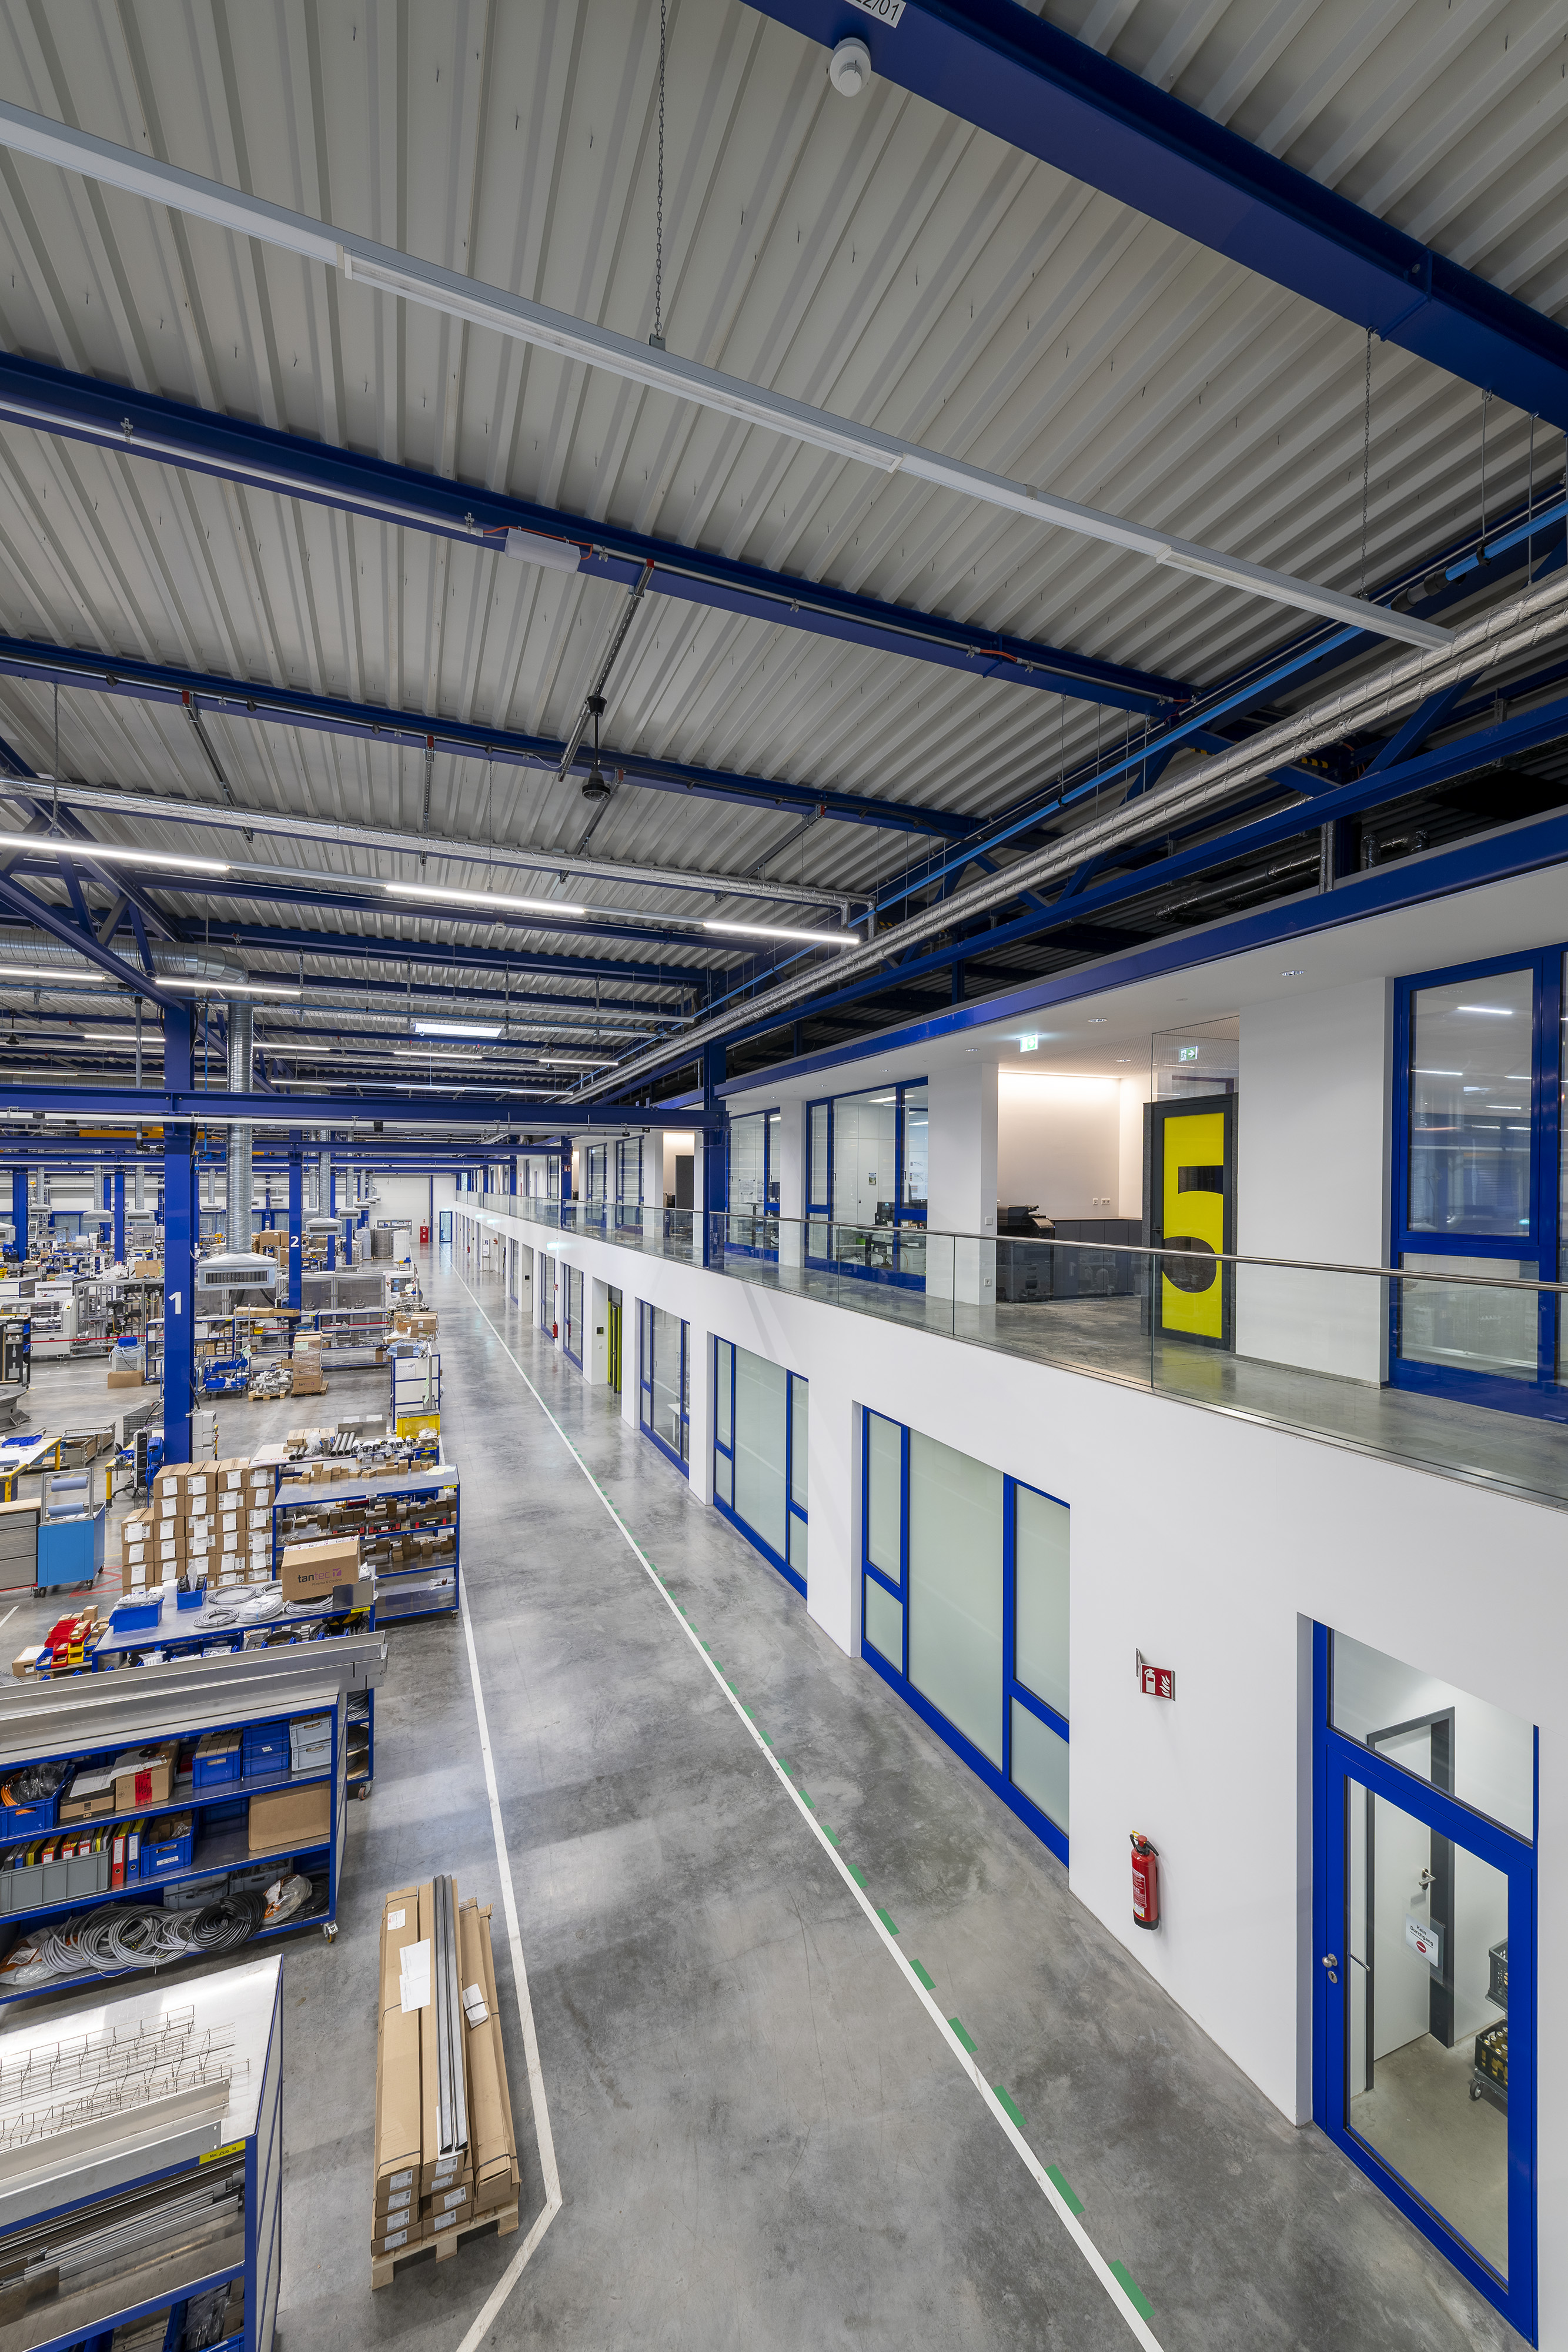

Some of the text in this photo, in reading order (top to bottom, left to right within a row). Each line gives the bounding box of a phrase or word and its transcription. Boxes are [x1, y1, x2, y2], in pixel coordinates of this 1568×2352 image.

[855, 0, 900, 21] /01
[290, 1235, 299, 1247] 2
[168, 1291, 182, 1315] 1
[297, 1571, 330, 1583] tantec
[1410, 1925, 1433, 1946] Durchgang
[1416, 1925, 1426, 1935] Kein
